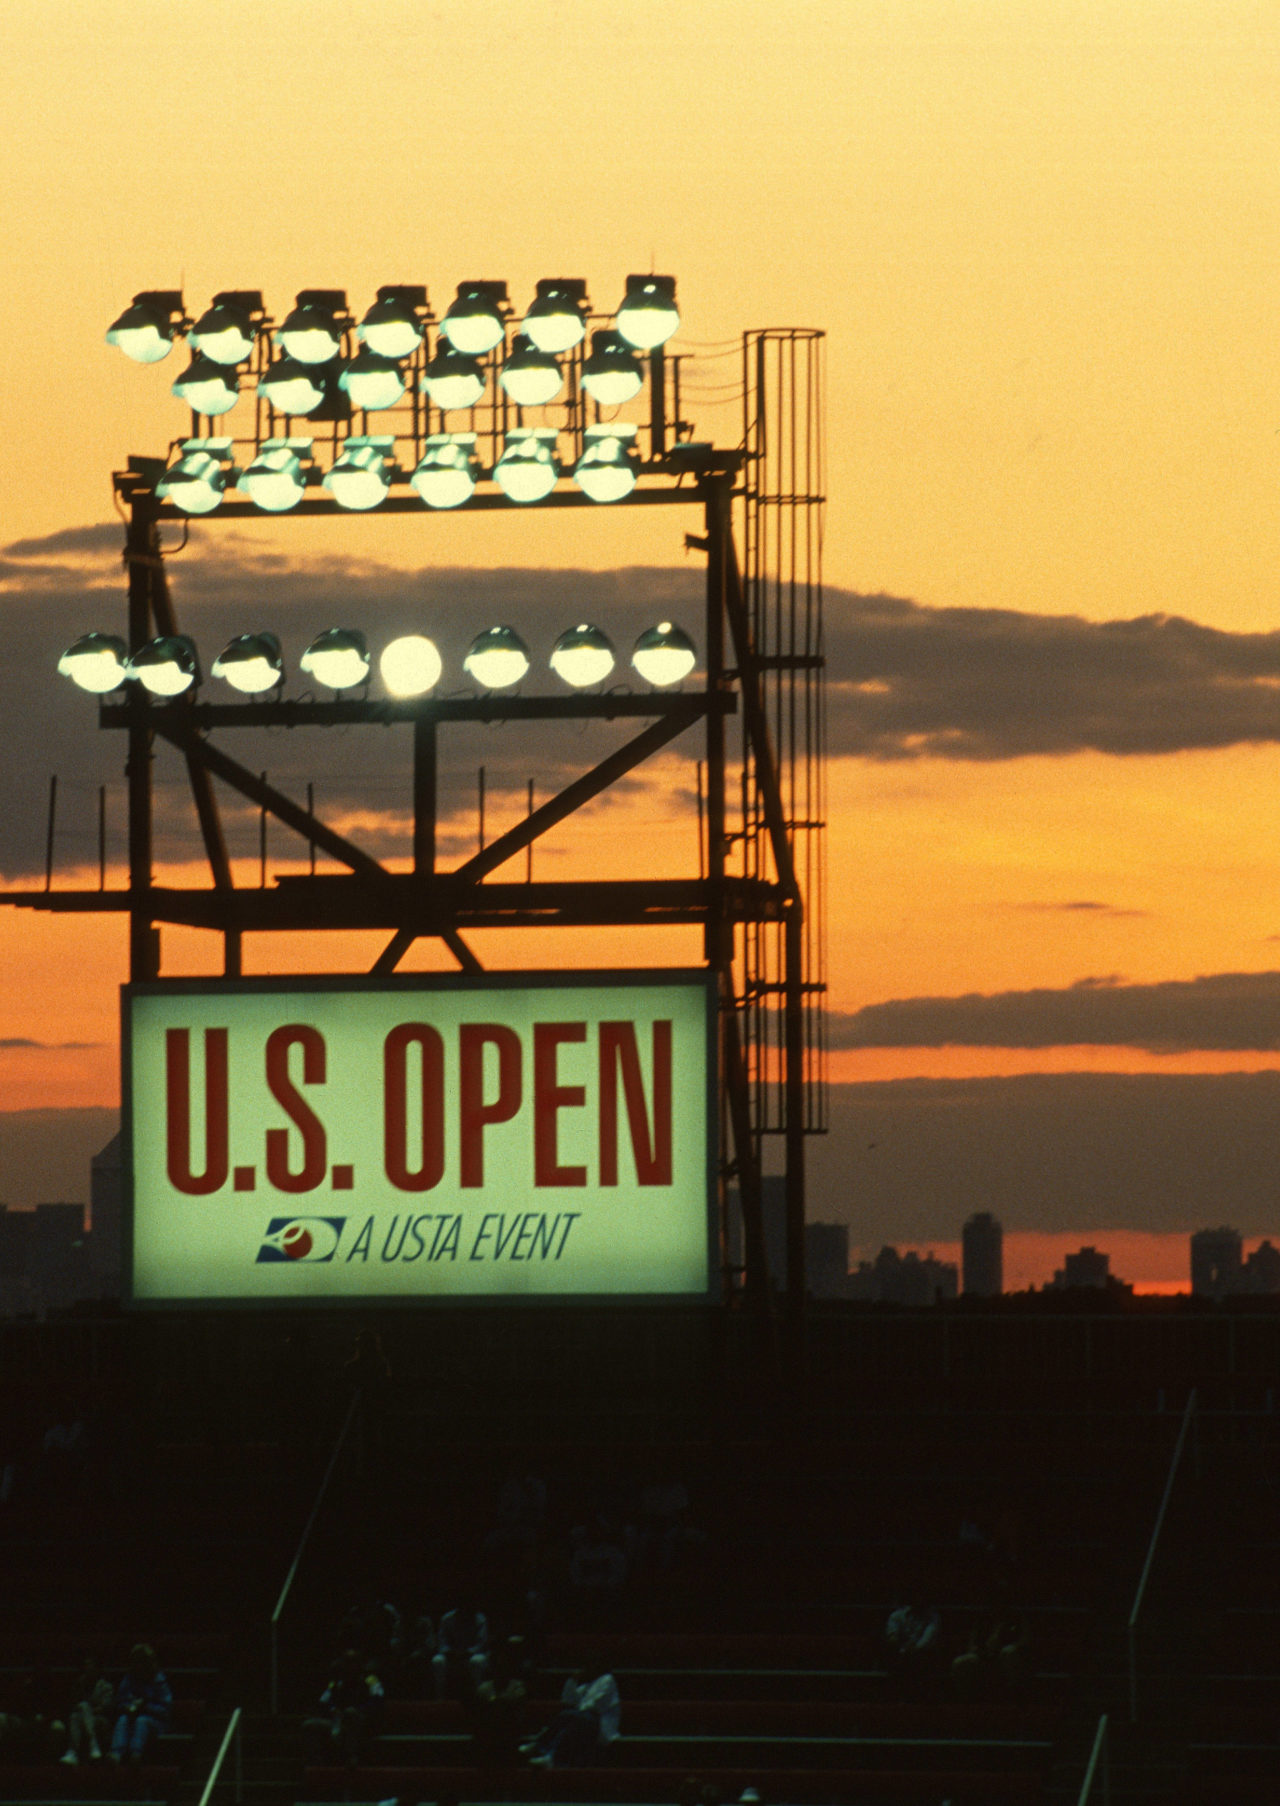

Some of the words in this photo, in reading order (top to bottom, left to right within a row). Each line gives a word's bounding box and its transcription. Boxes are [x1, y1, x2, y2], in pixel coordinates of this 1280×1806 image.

[164, 1021, 355, 1196] U.S.
[383, 1018, 674, 1194] OPEN
[345, 1215, 375, 1264] A
[380, 1213, 463, 1263] USTA
[469, 1212, 582, 1262] EVENT
